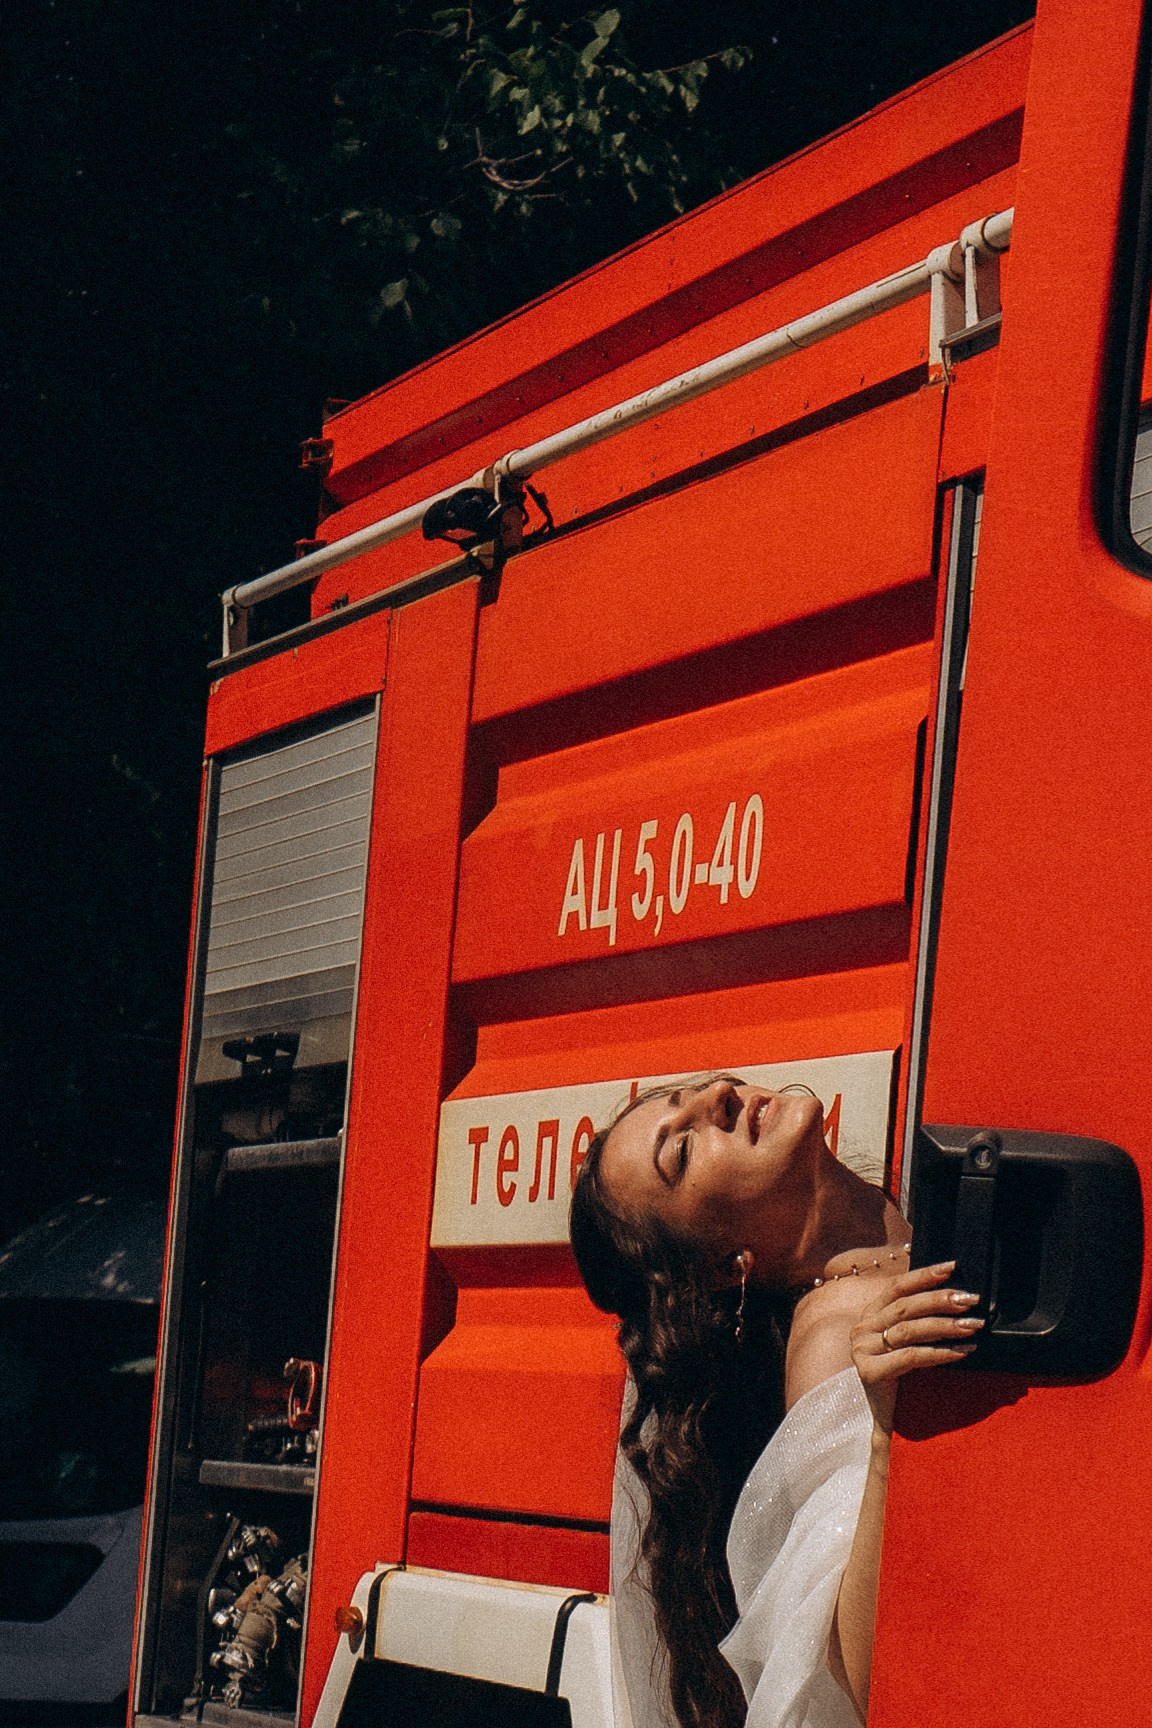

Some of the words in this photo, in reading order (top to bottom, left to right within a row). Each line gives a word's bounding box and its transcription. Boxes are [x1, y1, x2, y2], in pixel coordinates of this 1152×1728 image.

[558, 828, 622, 946] АЦ
[631, 793, 764, 937] 5,0-40
[468, 1081, 639, 1207] теле
